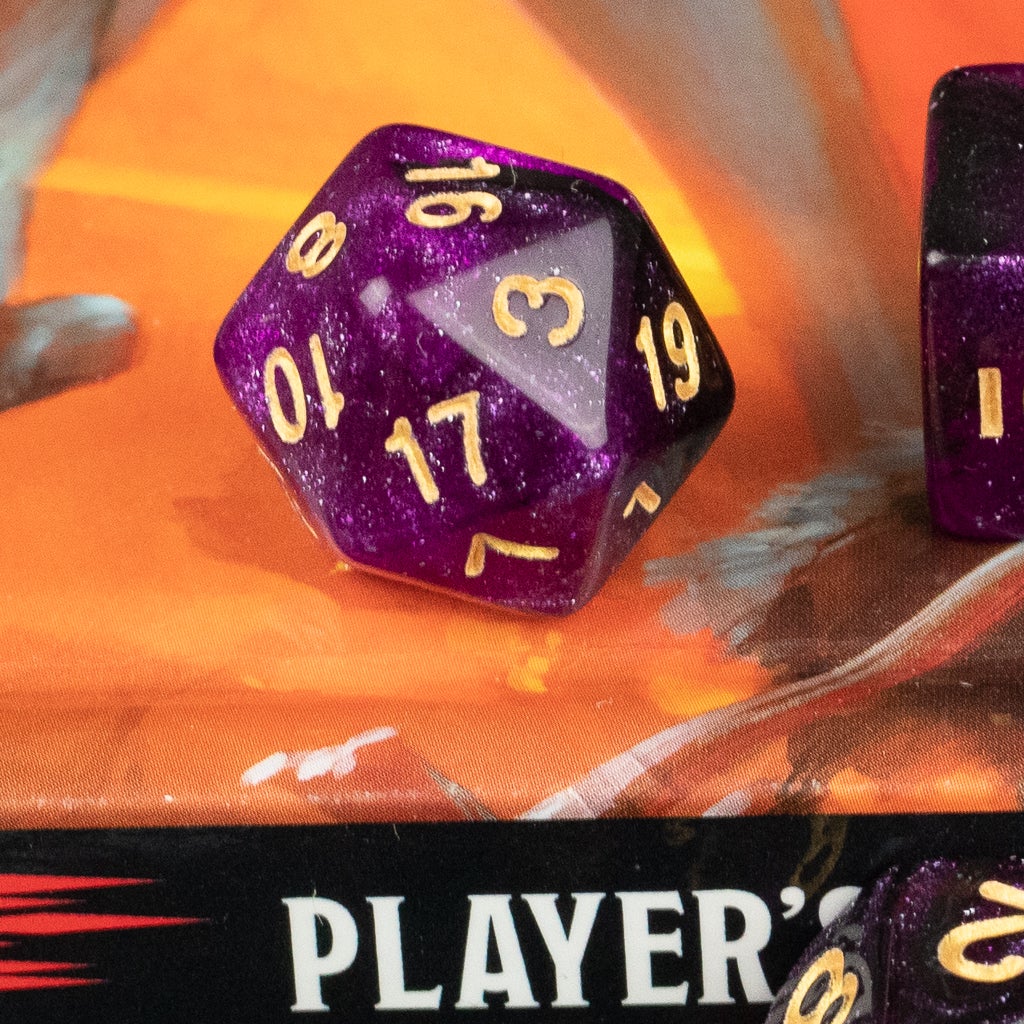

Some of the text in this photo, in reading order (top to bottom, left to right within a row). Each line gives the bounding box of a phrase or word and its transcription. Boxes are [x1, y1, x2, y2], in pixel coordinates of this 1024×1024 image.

[405, 159, 502, 227] 16
[286, 211, 346, 278] 8
[492, 274, 581, 346] 3
[266, 335, 344, 443] 10
[635, 301, 701, 411] 19
[385, 392, 486, 503] 17
